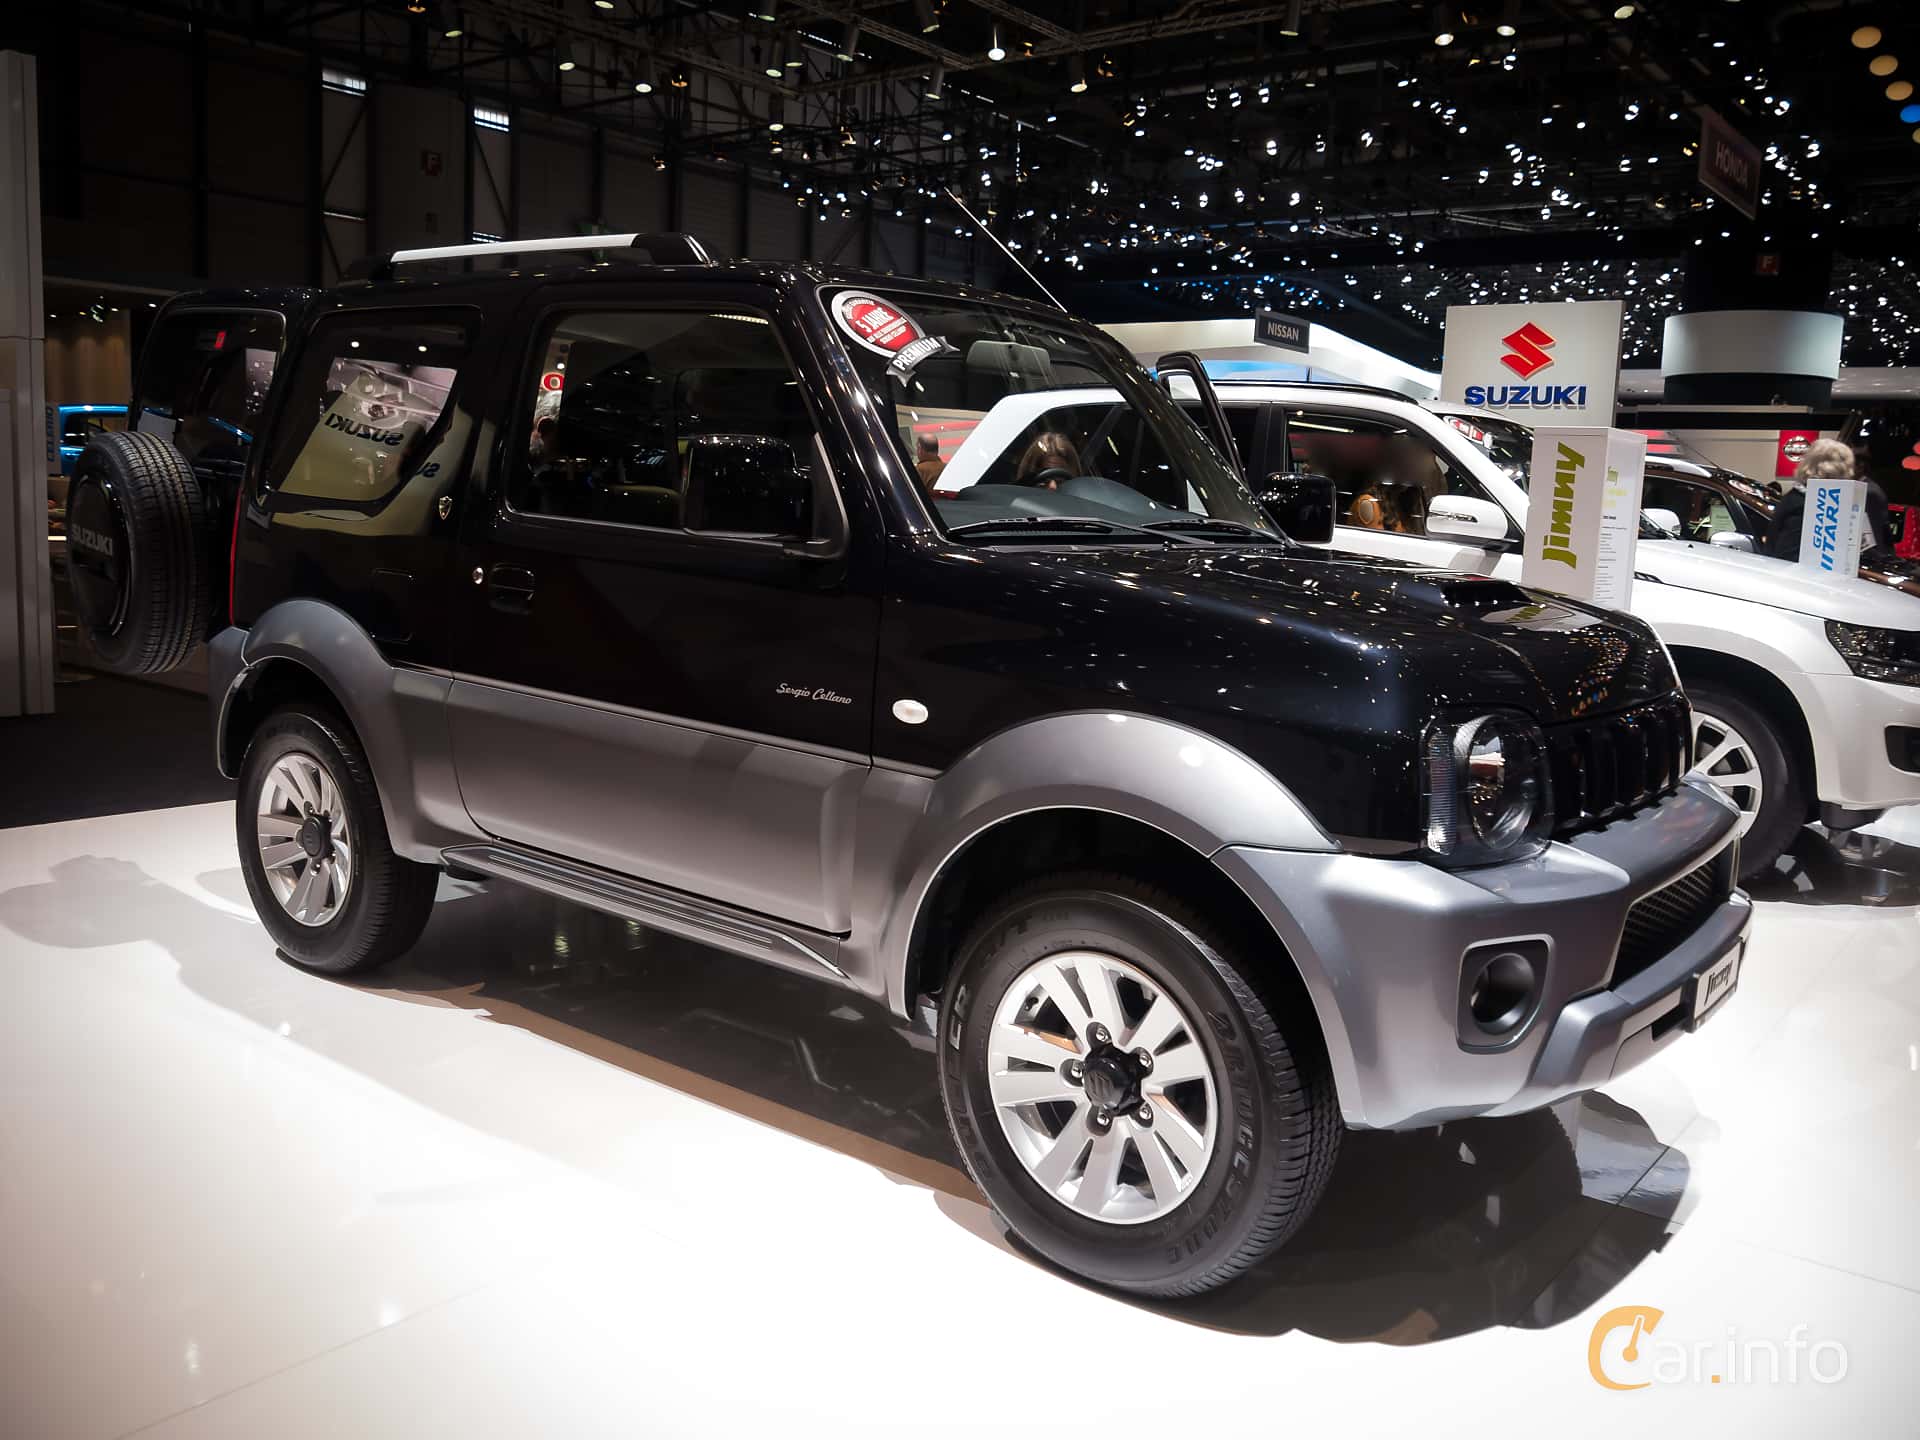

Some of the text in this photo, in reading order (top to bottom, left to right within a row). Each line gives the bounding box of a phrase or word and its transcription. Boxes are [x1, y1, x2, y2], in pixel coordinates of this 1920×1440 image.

[1715, 141, 1748, 186] HONDA
[855, 320, 872, 333] 5
[862, 307, 894, 330] JAHRE
[1267, 321, 1299, 341] NISSAN
[893, 337, 942, 371] PREMIUM
[1464, 386, 1587, 409] SUZUKI
[1542, 441, 1585, 570] Jimny
[1812, 487, 1827, 549] GRAND
[71, 522, 113, 556] SUZUKI
[776, 683, 852, 704] Sergio Cellano
